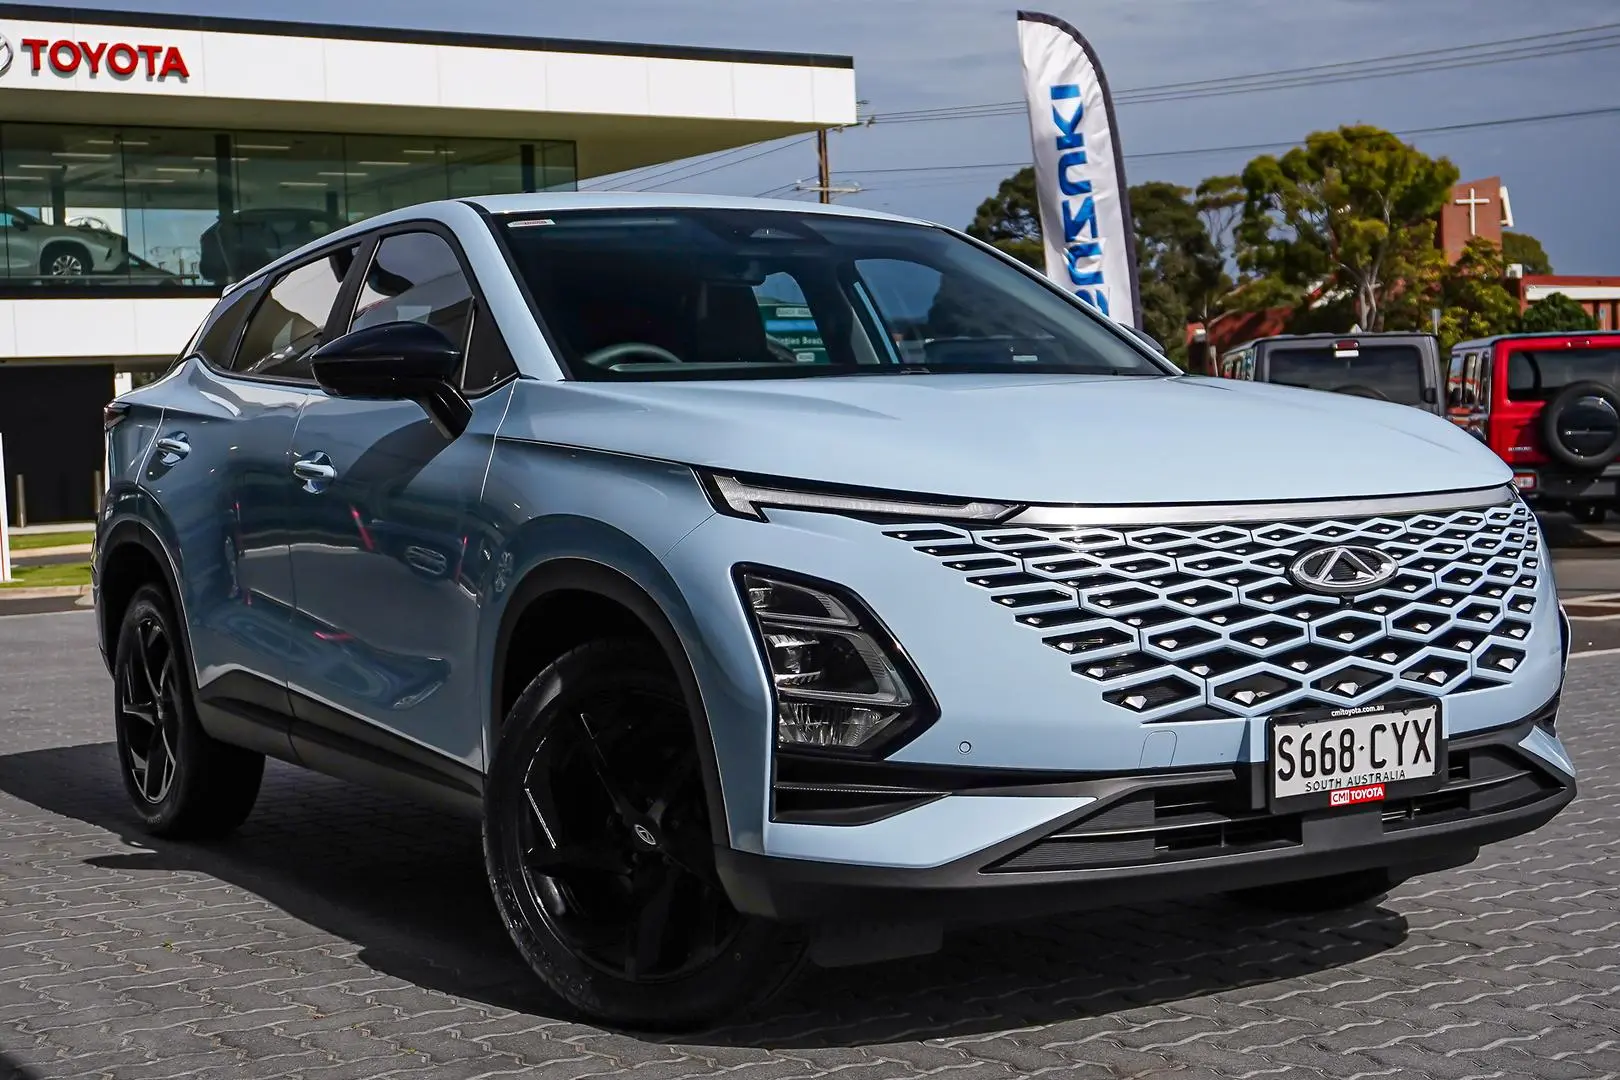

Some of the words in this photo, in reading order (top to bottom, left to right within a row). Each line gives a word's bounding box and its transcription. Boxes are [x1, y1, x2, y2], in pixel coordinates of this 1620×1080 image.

[22, 38, 190, 80] TOYOTA
[1331, 704, 1385, 717] cmitoyota.com.au
[1305, 778, 1342, 792] SOUTH
[1346, 769, 1406, 786] AUSTRALIA
[1332, 790, 1349, 803] CMI
[1350, 787, 1384, 801] TOYOTA
